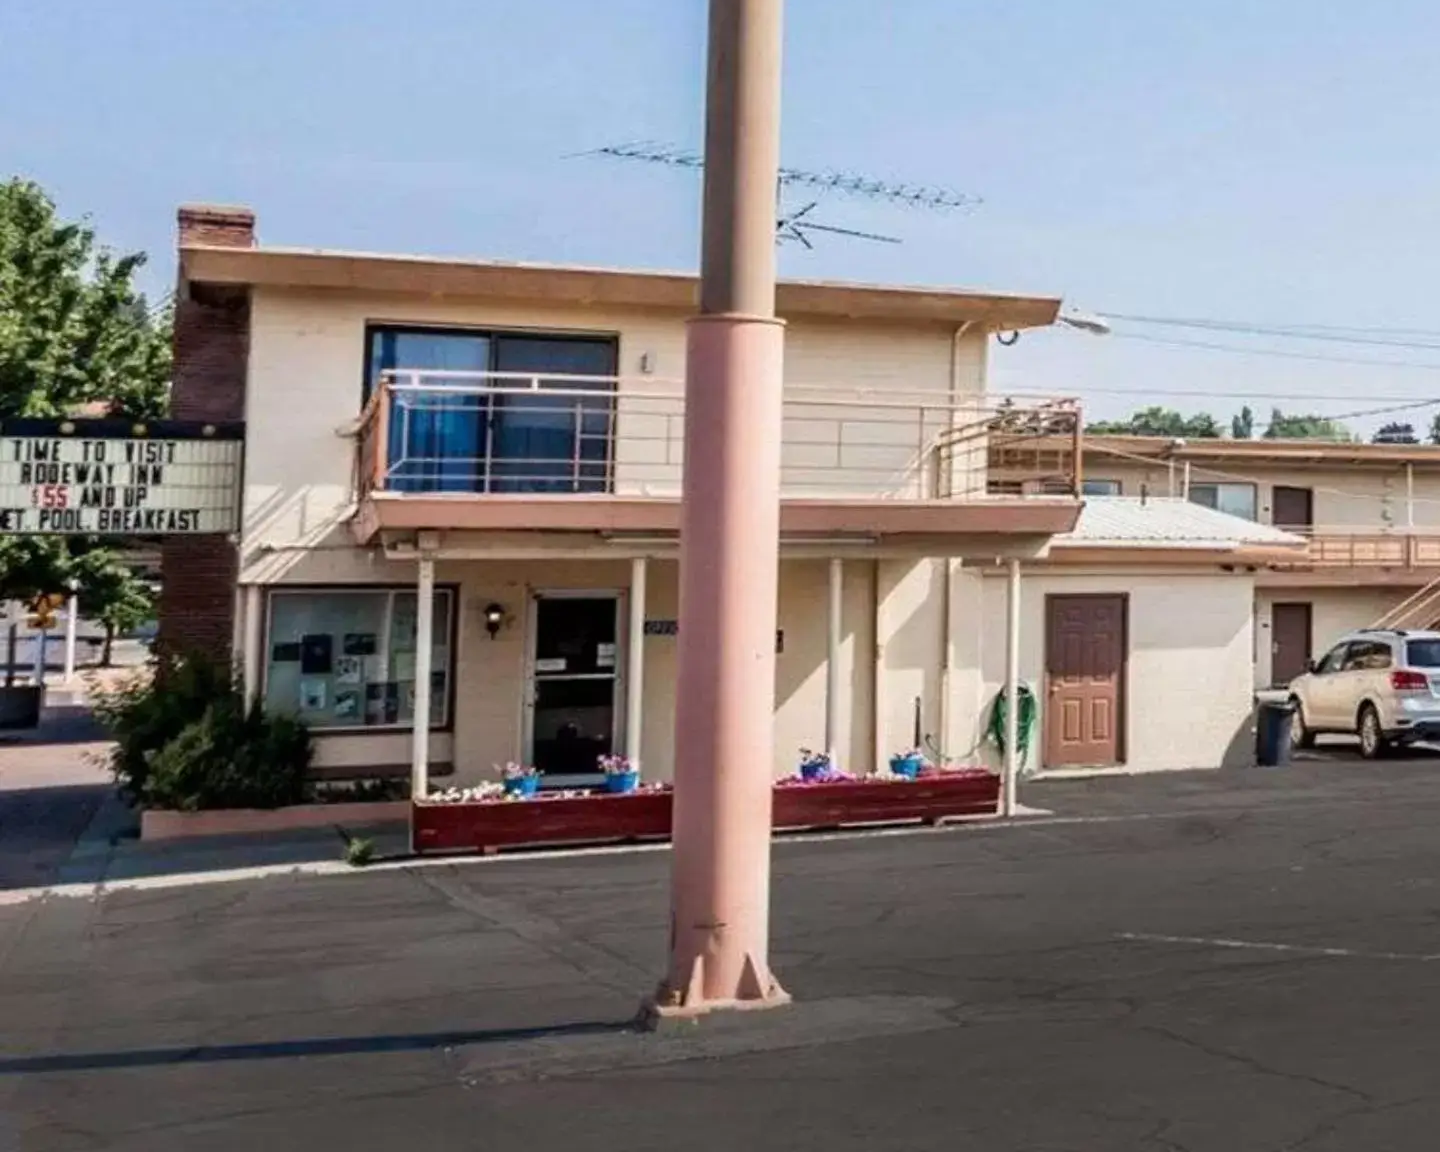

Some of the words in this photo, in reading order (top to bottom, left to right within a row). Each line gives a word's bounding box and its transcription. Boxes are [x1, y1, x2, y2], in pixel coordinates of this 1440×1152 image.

[12, 440, 61, 461] TIME
[82, 441, 106, 462] TO
[125, 442, 176, 463] VISIT
[21, 463, 113, 484] RODEWAY
[130, 465, 162, 485] INN
[80, 487, 116, 507] AND
[124, 487, 147, 507] UP
[98, 509, 200, 530] BREAKFAST
